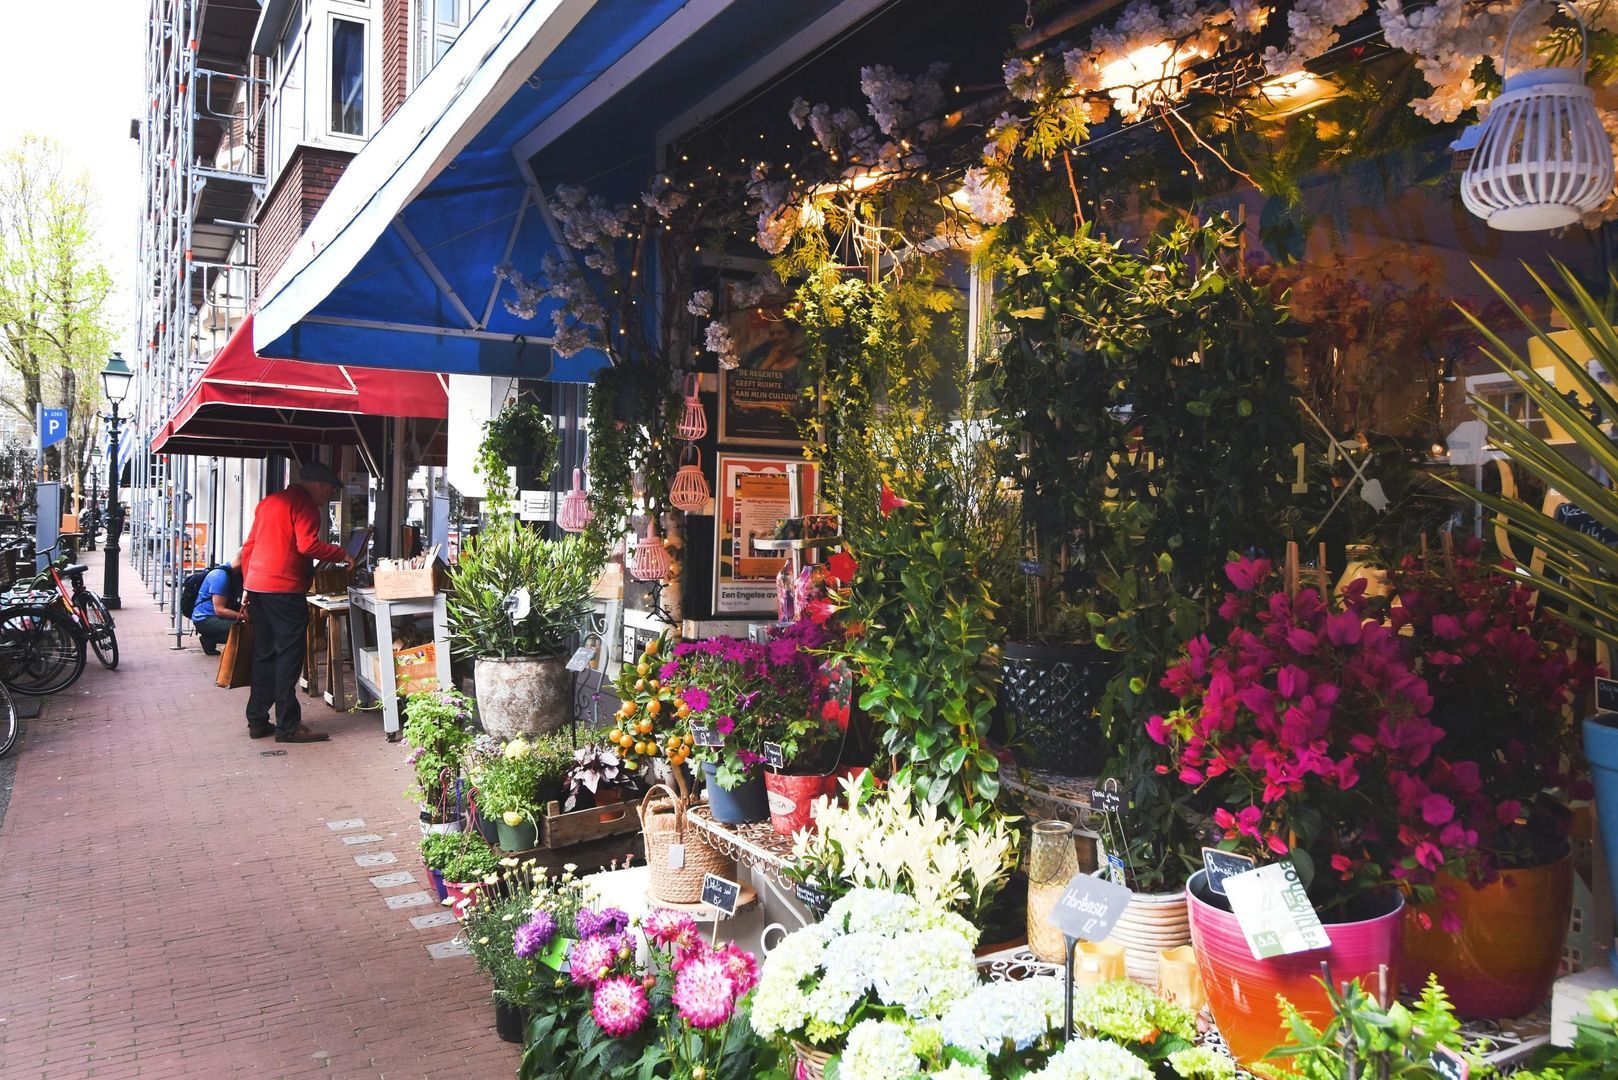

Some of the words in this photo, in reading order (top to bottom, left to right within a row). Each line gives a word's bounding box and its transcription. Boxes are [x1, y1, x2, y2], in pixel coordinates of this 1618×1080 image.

[750, 370, 784, 379] REGENTES
[735, 390, 749, 398] AAN
[49, 419, 60, 435] P
[721, 591, 736, 599] Een
[736, 591, 765, 600] Engelse
